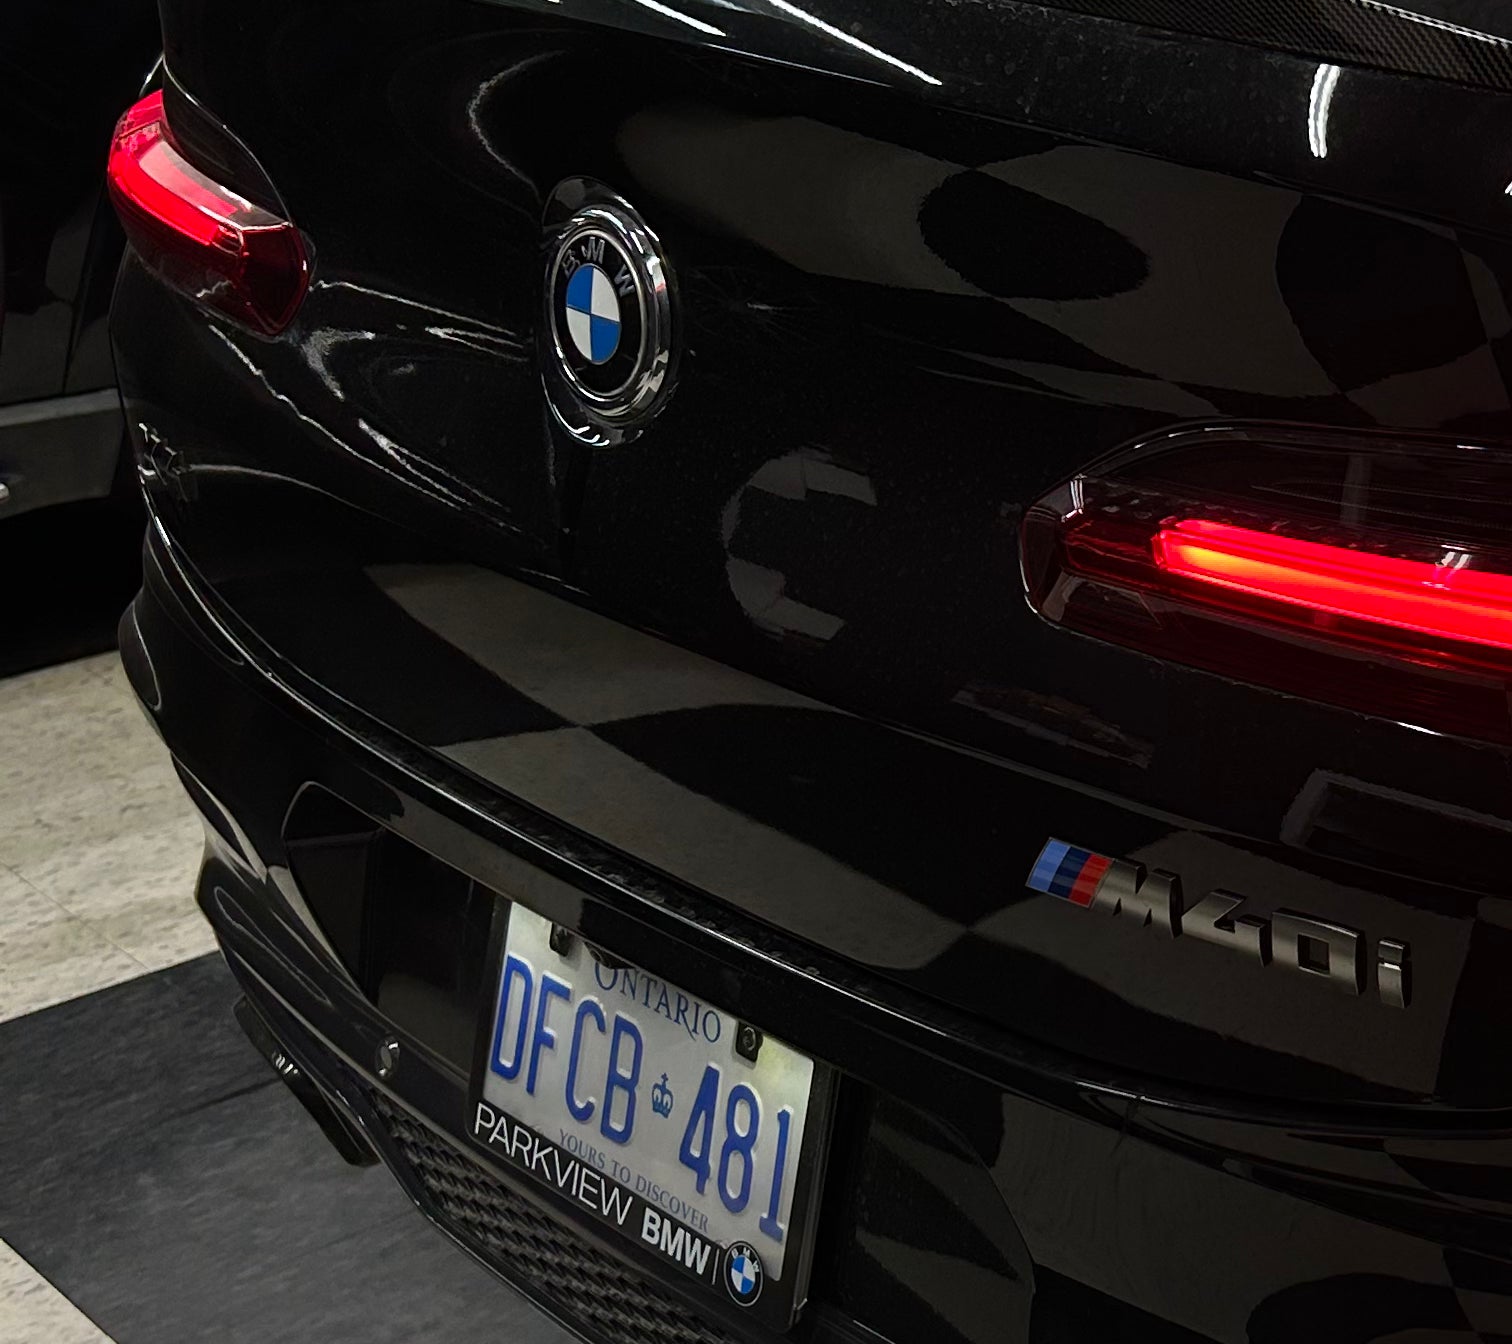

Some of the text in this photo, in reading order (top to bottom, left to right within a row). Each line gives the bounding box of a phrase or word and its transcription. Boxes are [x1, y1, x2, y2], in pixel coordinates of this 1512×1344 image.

[560, 236, 635, 298] BMW
[1096, 857, 1412, 1009] M40i
[595, 961, 720, 1043] ONTARIO
[490, 954, 791, 1242] DFCB 481
[474, 1102, 711, 1276] PARKVIEW BMW
[559, 1128, 709, 1234] YOURS TO DISCOVER
